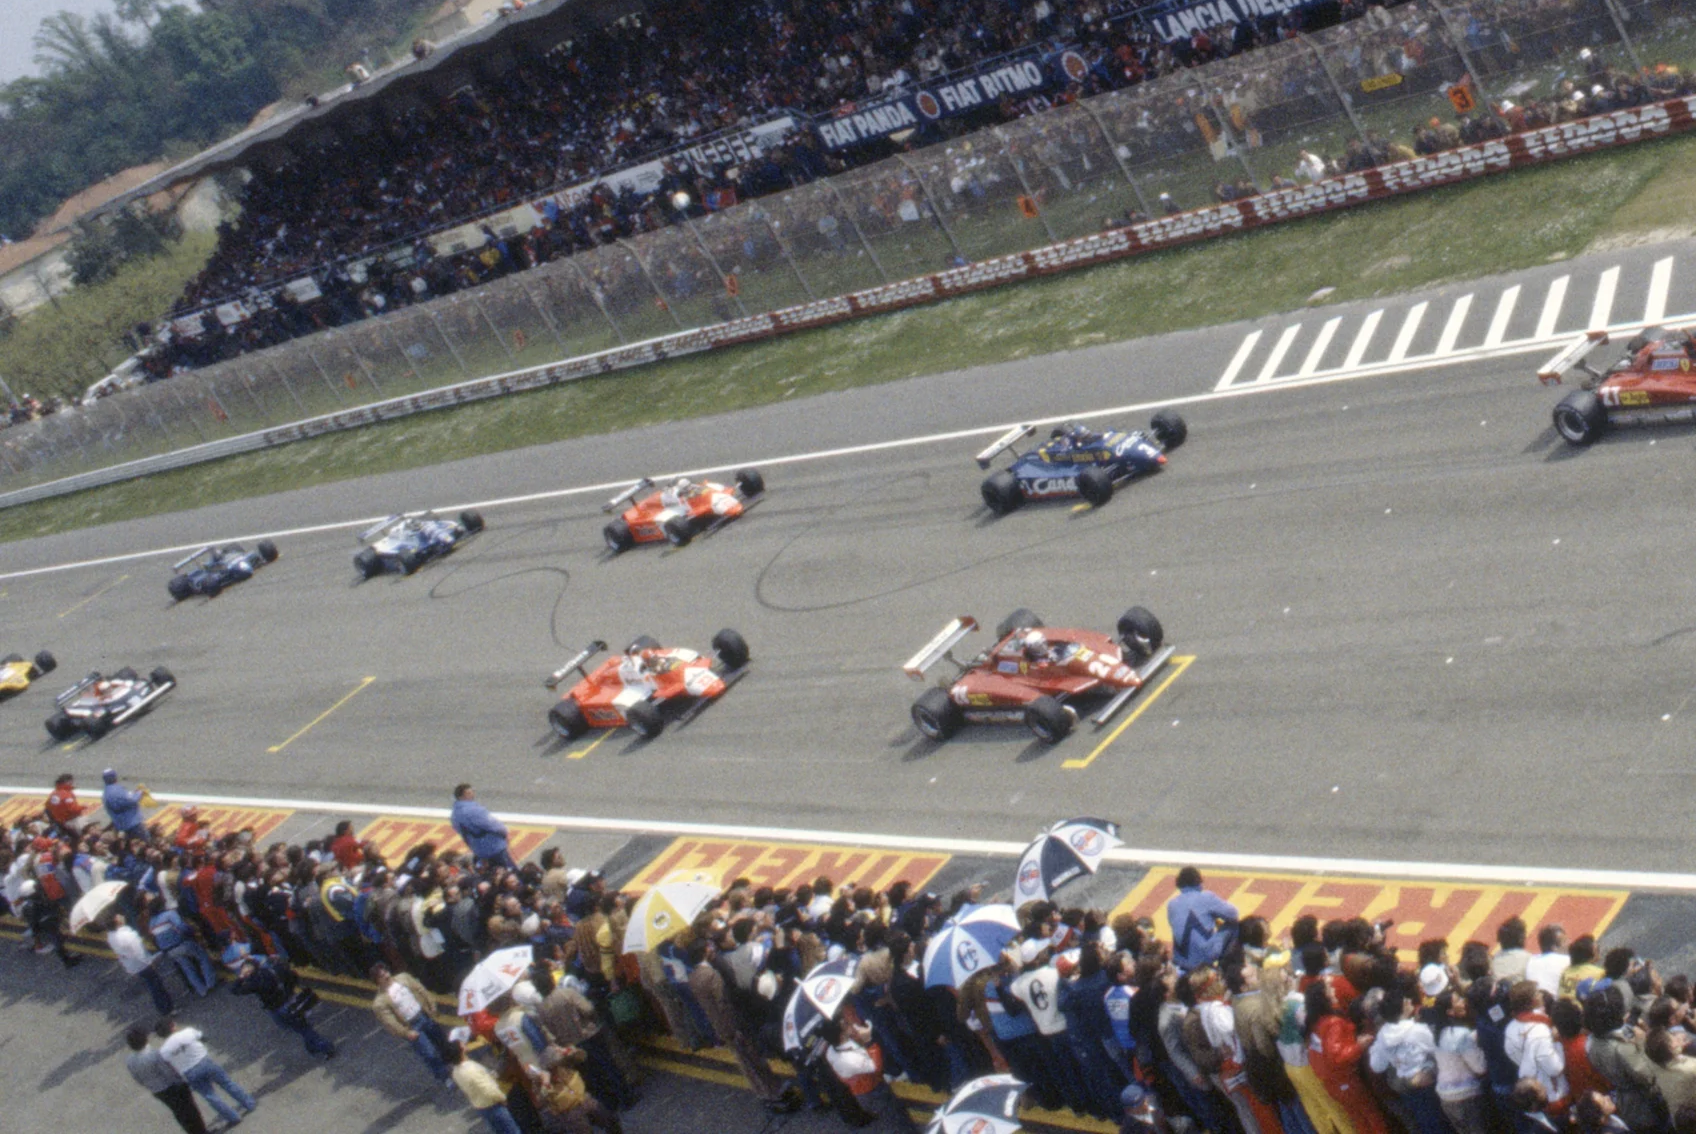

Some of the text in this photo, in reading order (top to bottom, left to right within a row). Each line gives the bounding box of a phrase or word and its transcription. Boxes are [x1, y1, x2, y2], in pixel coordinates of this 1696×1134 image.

[939, 79, 984, 112] FIAT
[1452, 86, 1472, 108] 3
[819, 101, 917, 149] FIAT PANDA
[1521, 103, 1671, 159] FERODO
[1601, 386, 1622, 406] 27
[1033, 477, 1079, 495] Cand
